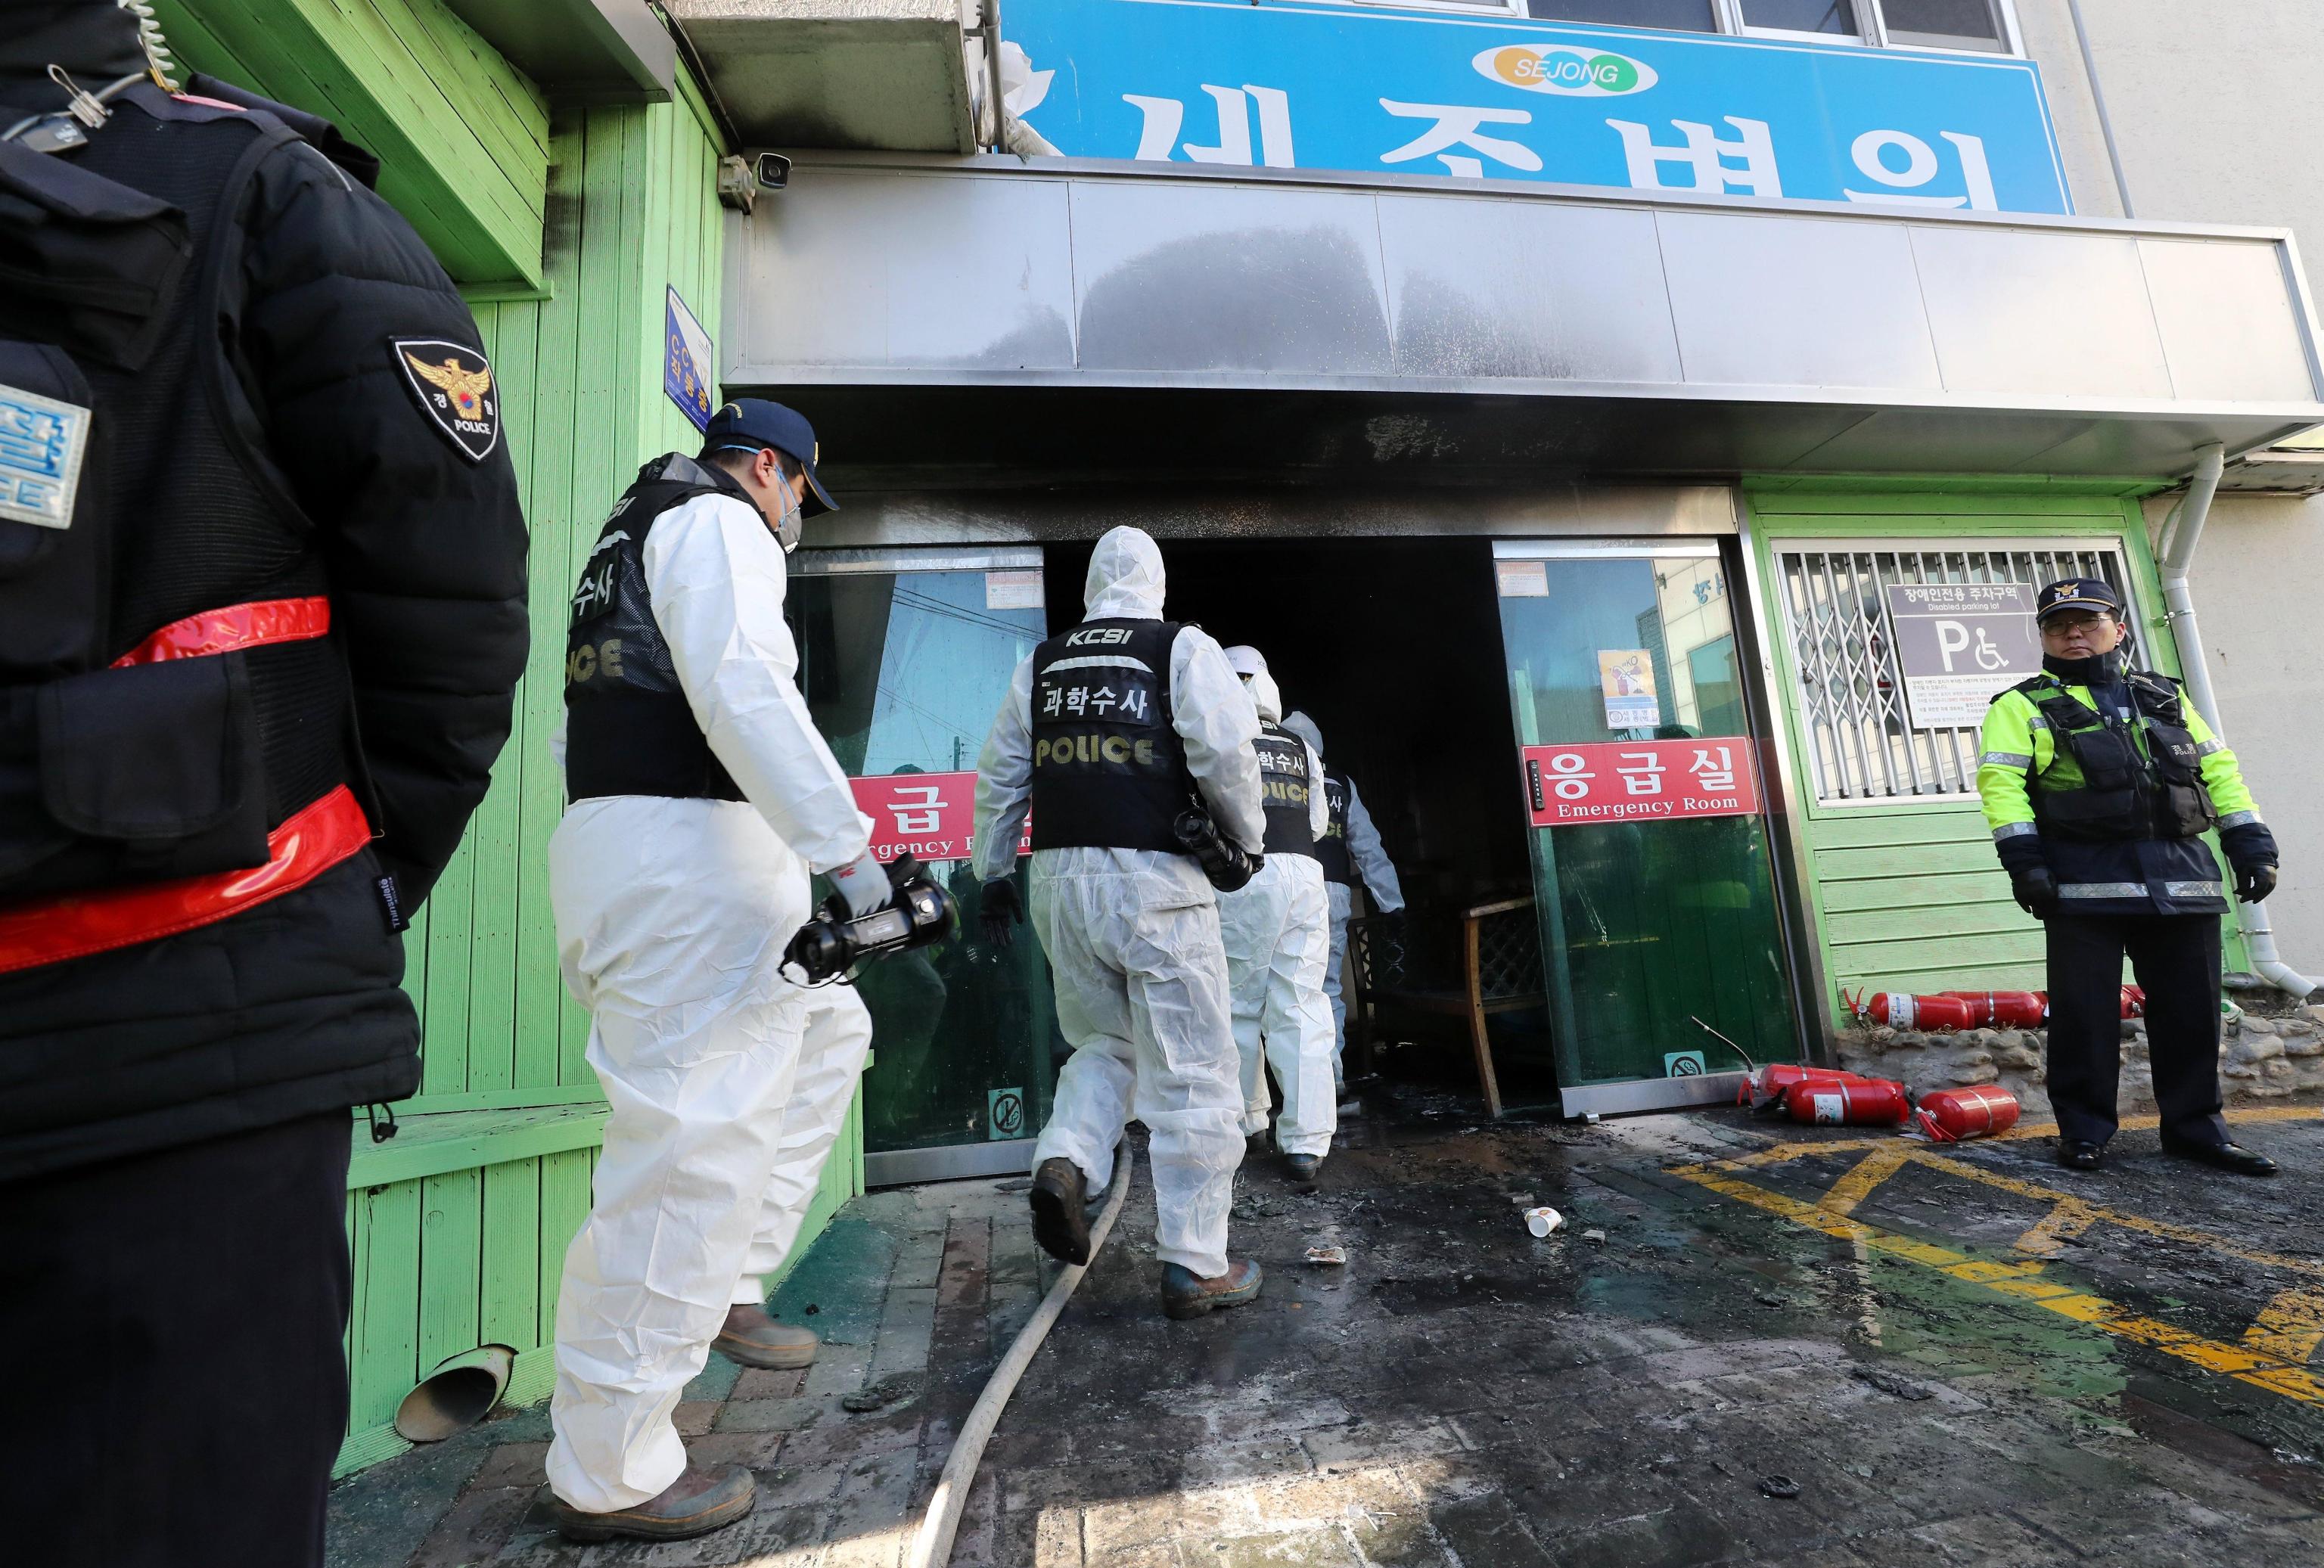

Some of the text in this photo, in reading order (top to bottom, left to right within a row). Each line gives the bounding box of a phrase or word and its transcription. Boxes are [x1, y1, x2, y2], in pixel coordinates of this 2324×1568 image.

[1514, 58, 1620, 83] SEJONG
[454, 419, 492, 435] POLICE
[1904, 586, 2018, 603] 장애인전용 주차구역
[1928, 603, 1960, 611] Disabled
[1962, 602, 1989, 611] parking
[1065, 629, 1134, 647] KCSI
[1935, 620, 1970, 672] P
[1043, 686, 1148, 719] 과학수사
[1036, 734, 1154, 768] POLICE
[1544, 747, 1736, 800] 응급실
[1558, 796, 1738, 818] Emergency Room
